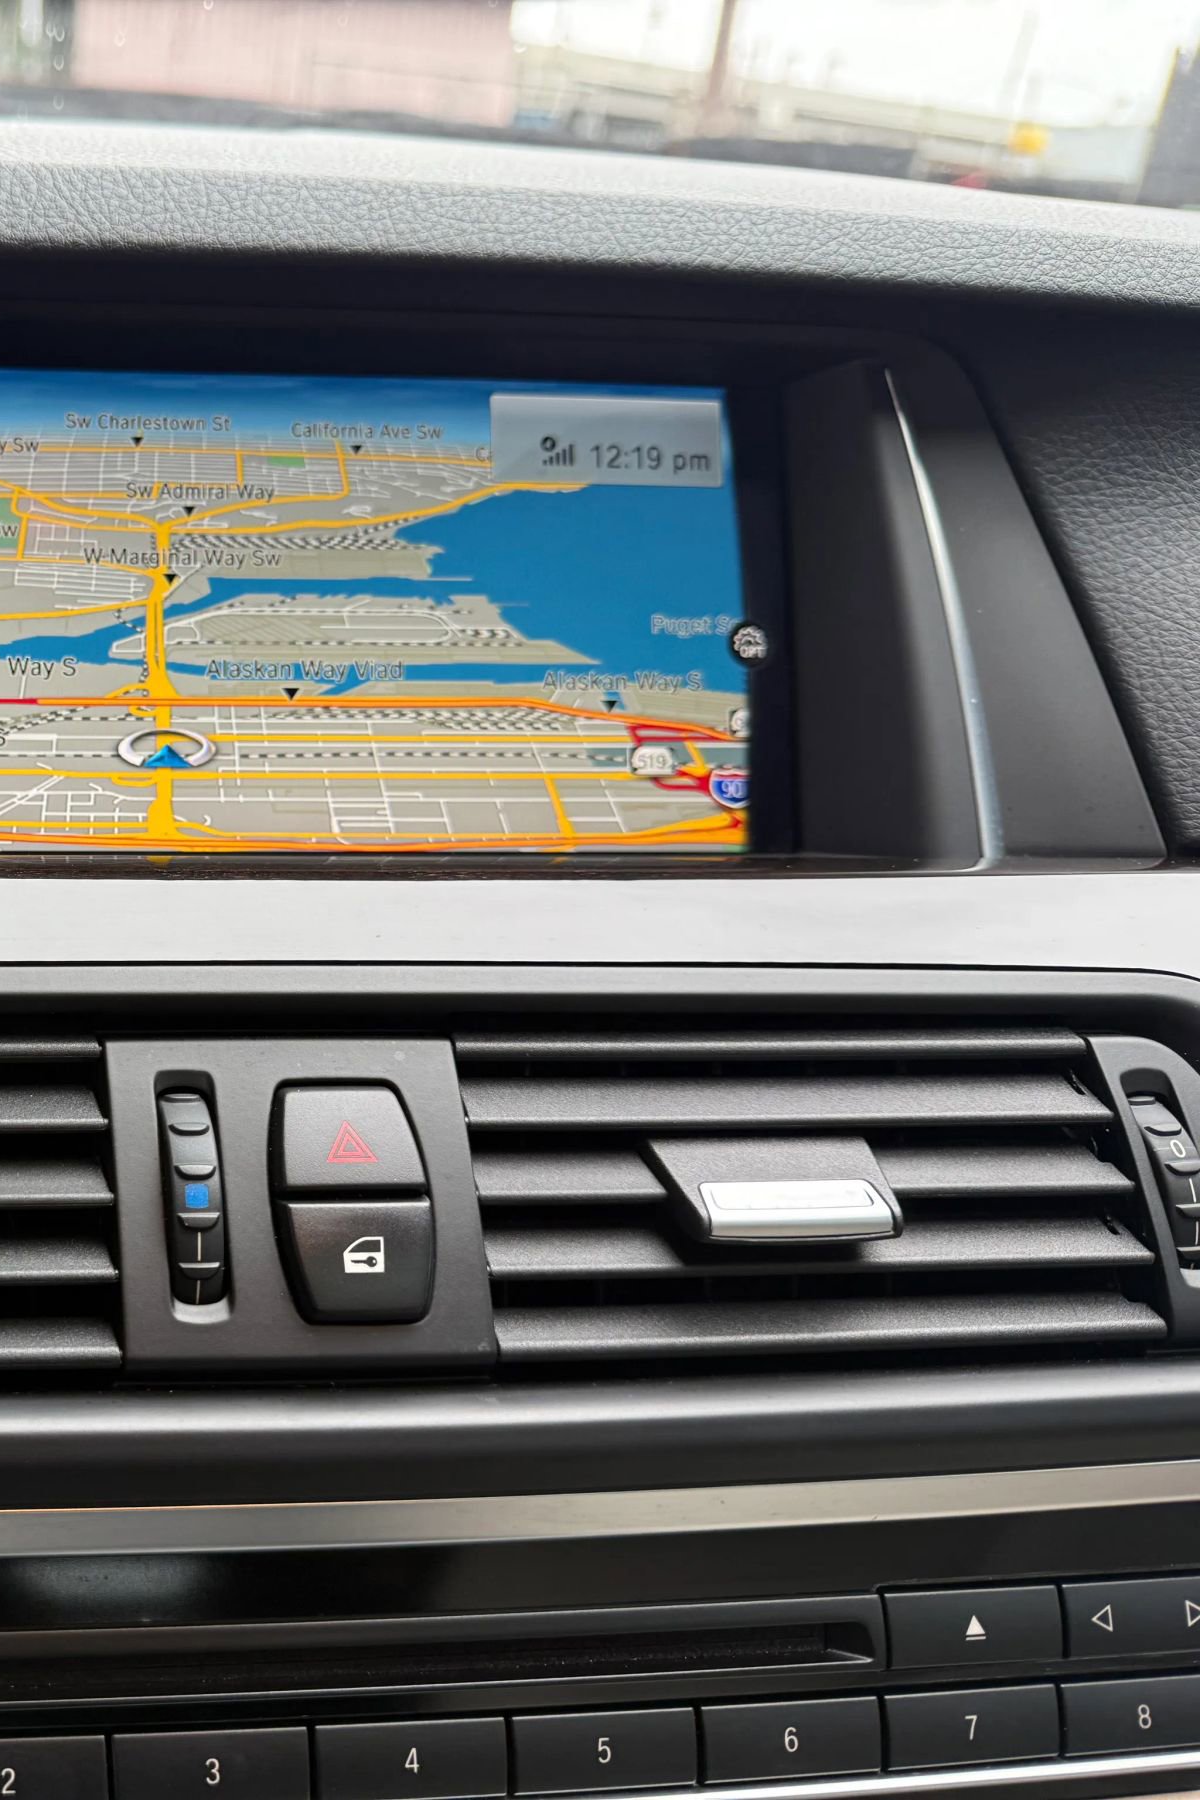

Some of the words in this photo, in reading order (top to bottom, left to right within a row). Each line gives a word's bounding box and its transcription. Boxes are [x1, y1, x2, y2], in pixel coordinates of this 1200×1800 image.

[65, 413, 91, 429] Sw
[98, 414, 206, 431] Charlestown
[212, 416, 230, 432] St
[291, 422, 374, 439] California
[379, 423, 410, 440] Ave
[416, 424, 442, 440] Sw
[13, 437, 39, 452] Sw
[590, 444, 662, 471] 12:19
[672, 452, 711, 475] pm
[126, 482, 151, 498] Sw
[160, 483, 229, 500] Admiral
[237, 484, 275, 504] Way
[84, 548, 101, 564] W
[110, 548, 197, 569] Marginal
[204, 550, 246, 570] Way
[252, 550, 282, 567] Sw
[650, 615, 712, 638] Puget
[8, 657, 54, 679] Way
[62, 658, 77, 677] S
[206, 659, 291, 680] Alaskan
[300, 660, 346, 684] Way
[353, 660, 403, 680] Viad
[542, 671, 627, 691] Alaskan
[633, 671, 683, 694] Way
[687, 672, 702, 692] S
[638, 753, 666, 769] 519
[720, 781, 744, 798] 90
[965, 1715, 979, 1741] 7
[1137, 1704, 1152, 1731] 8
[597, 1737, 612, 1764] 5
[783, 1727, 799, 1754] 6
[204, 1758, 221, 1786] 3
[404, 1748, 420, 1775] 4
[0, 1768, 17, 1796] 2
